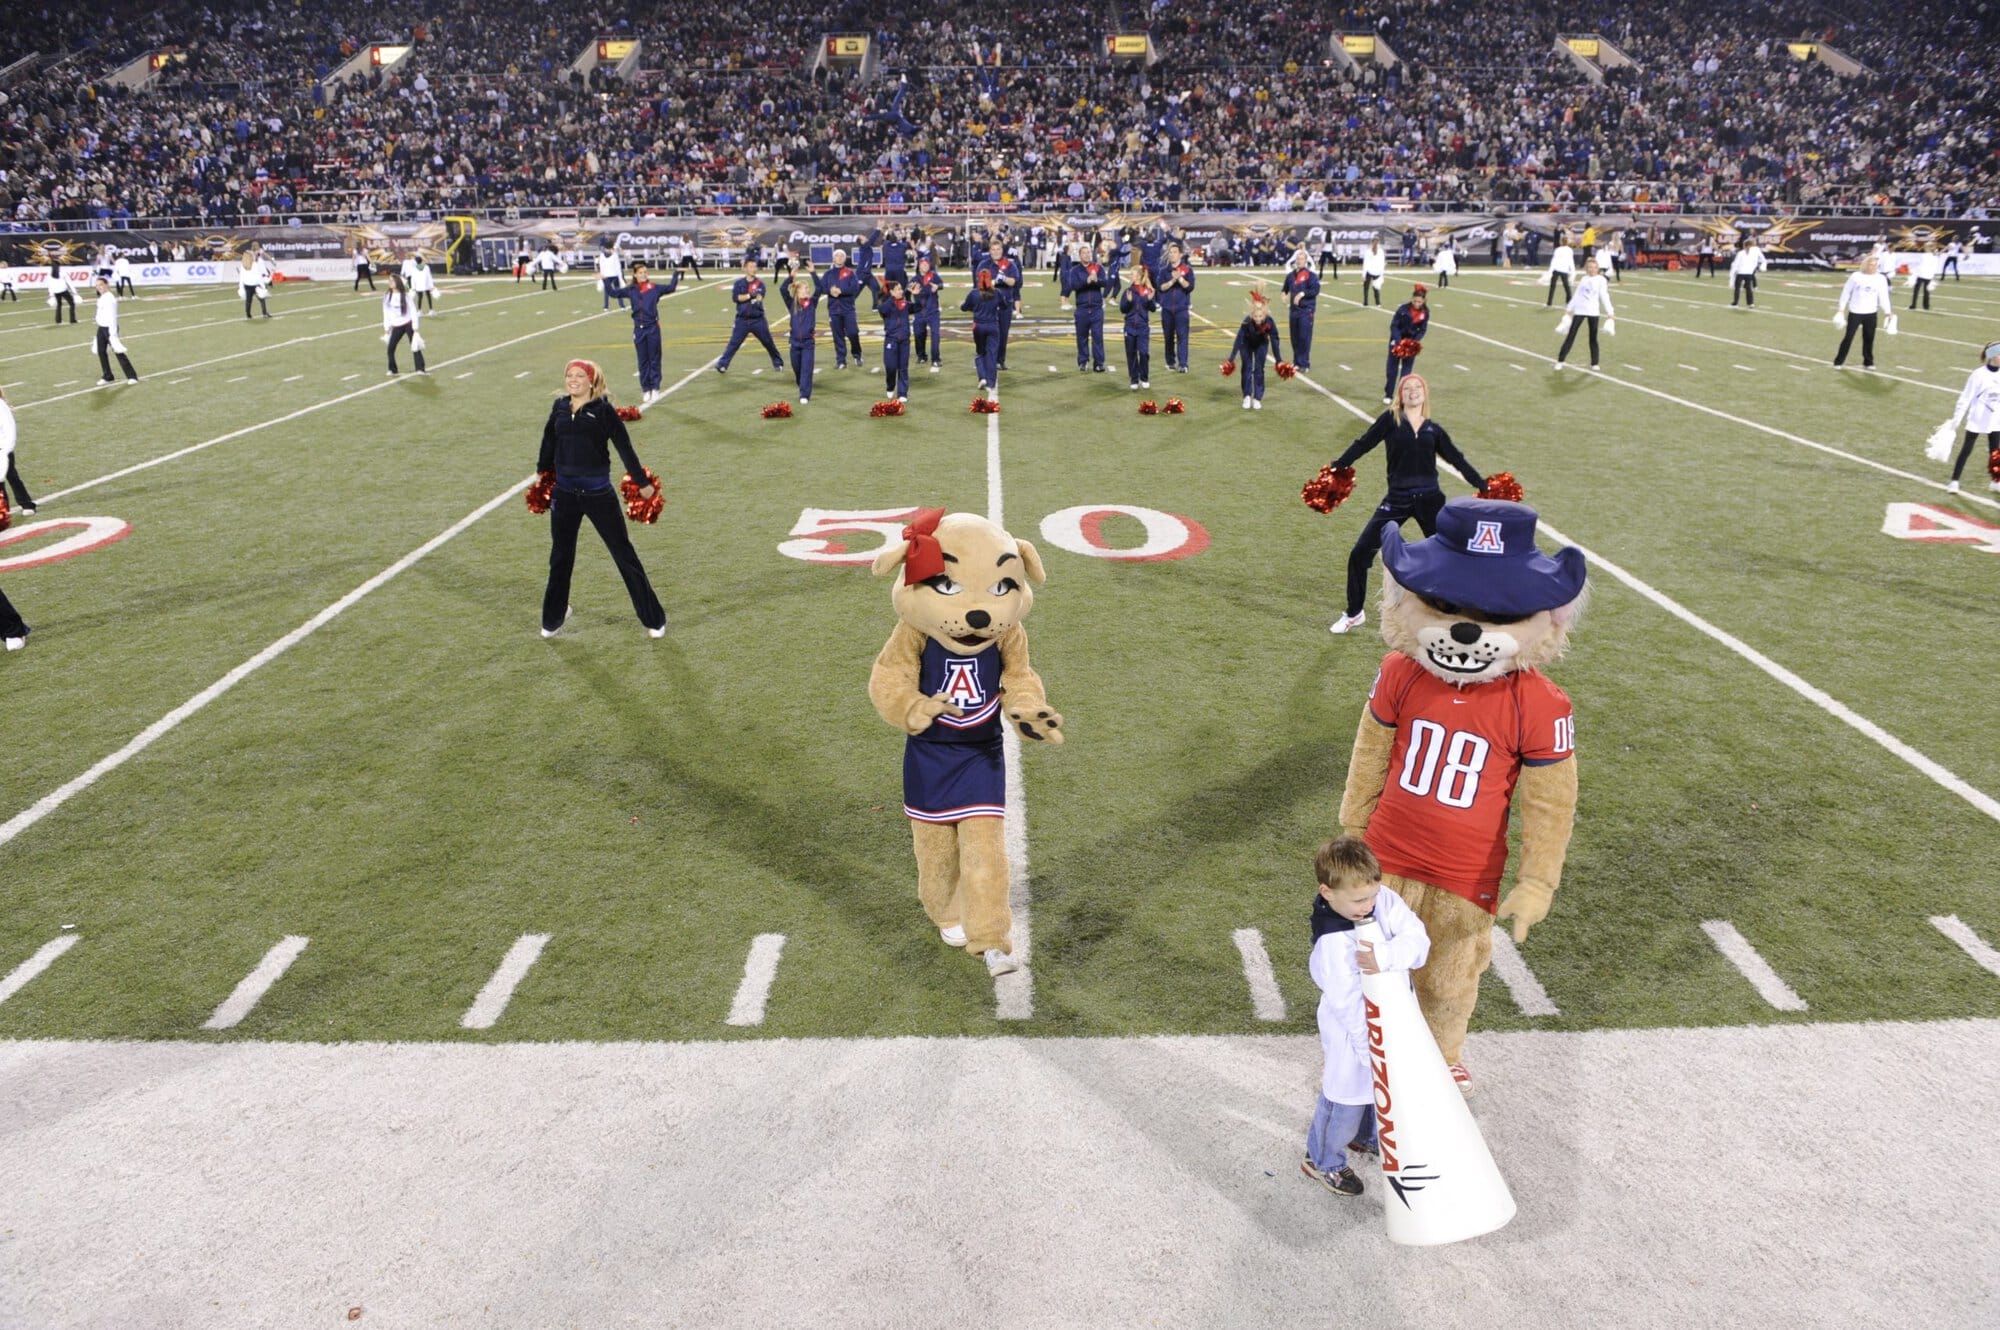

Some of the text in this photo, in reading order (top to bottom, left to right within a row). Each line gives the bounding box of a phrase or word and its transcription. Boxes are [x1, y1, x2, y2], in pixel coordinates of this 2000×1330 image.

[617, 232, 683, 245] Pionee
[788, 230, 859, 243] Pioneer
[261, 242, 341, 251] VisitLasVegas.com
[142, 267, 171, 277] COX
[188, 265, 217, 275] COX
[18, 273, 47, 283] OUT
[1466, 520, 1505, 554] A
[937, 657, 986, 710] A
[1398, 717, 1491, 809] 08
[1362, 994, 1399, 1172] ARIZONA
